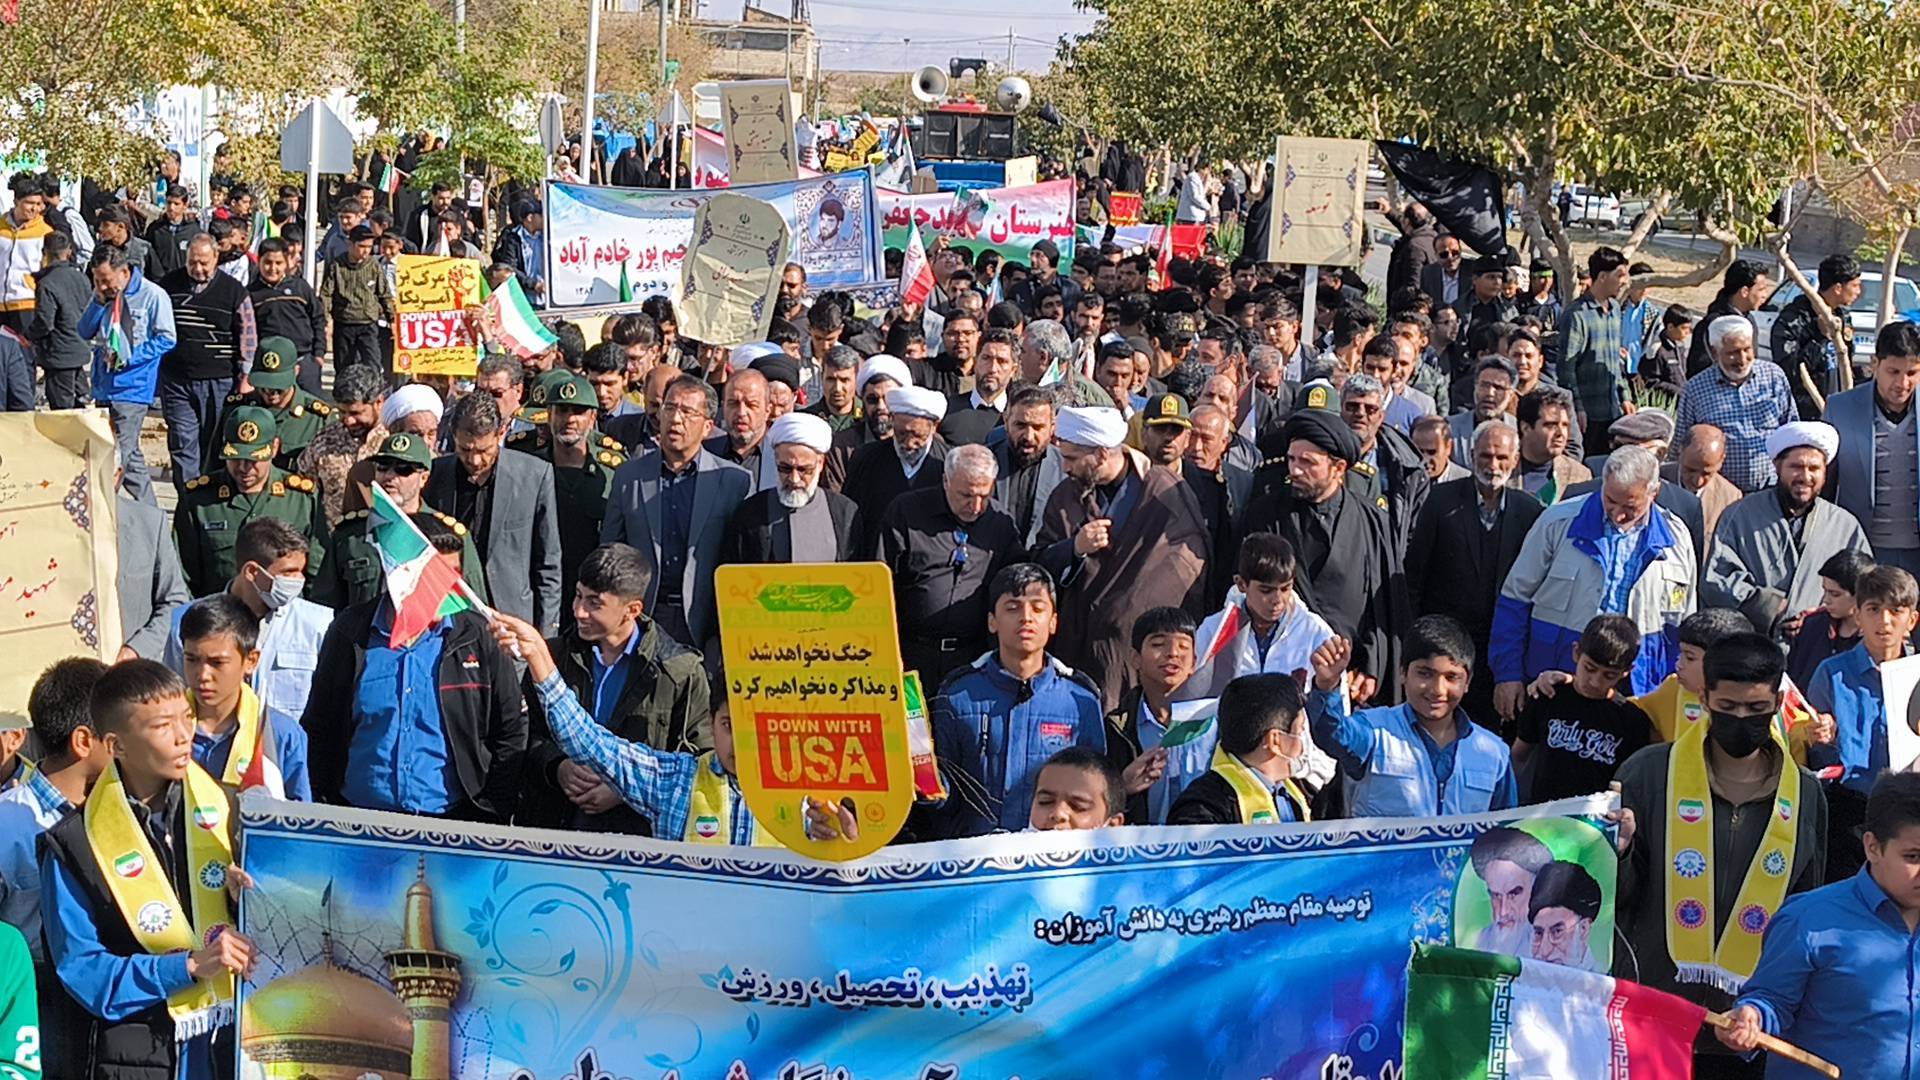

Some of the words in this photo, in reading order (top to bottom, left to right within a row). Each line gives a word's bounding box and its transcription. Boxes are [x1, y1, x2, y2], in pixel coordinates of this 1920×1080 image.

[559, 236, 591, 274] آباد
[593, 238, 630, 270] خادم
[412, 270, 446, 290] مرگ
[398, 287, 451, 310] آمریکا
[400, 311, 438, 323] DOWN
[400, 318, 475, 350] USA
[749, 642, 772, 662] شد
[774, 642, 830, 668] نخواهد
[833, 643, 872, 667] جنگ
[732, 675, 761, 701] کرد
[764, 674, 827, 701] نخواهیم
[829, 675, 886, 701] مذاکره
[889, 684, 899, 701] و
[767, 719, 820, 733] DOWN
[825, 720, 872, 734] WITH
[768, 735, 877, 785] USA
[1187, 905, 1242, 932] رهبری
[1243, 898, 1287, 928] معظم
[1289, 895, 1323, 926] مقام
[1325, 890, 1373, 920] توصیه
[1035, 906, 1116, 944] آموزان:
[1119, 906, 1165, 938] دانش
[1168, 909, 1185, 933] به
[721, 967, 806, 1007] ورزش
